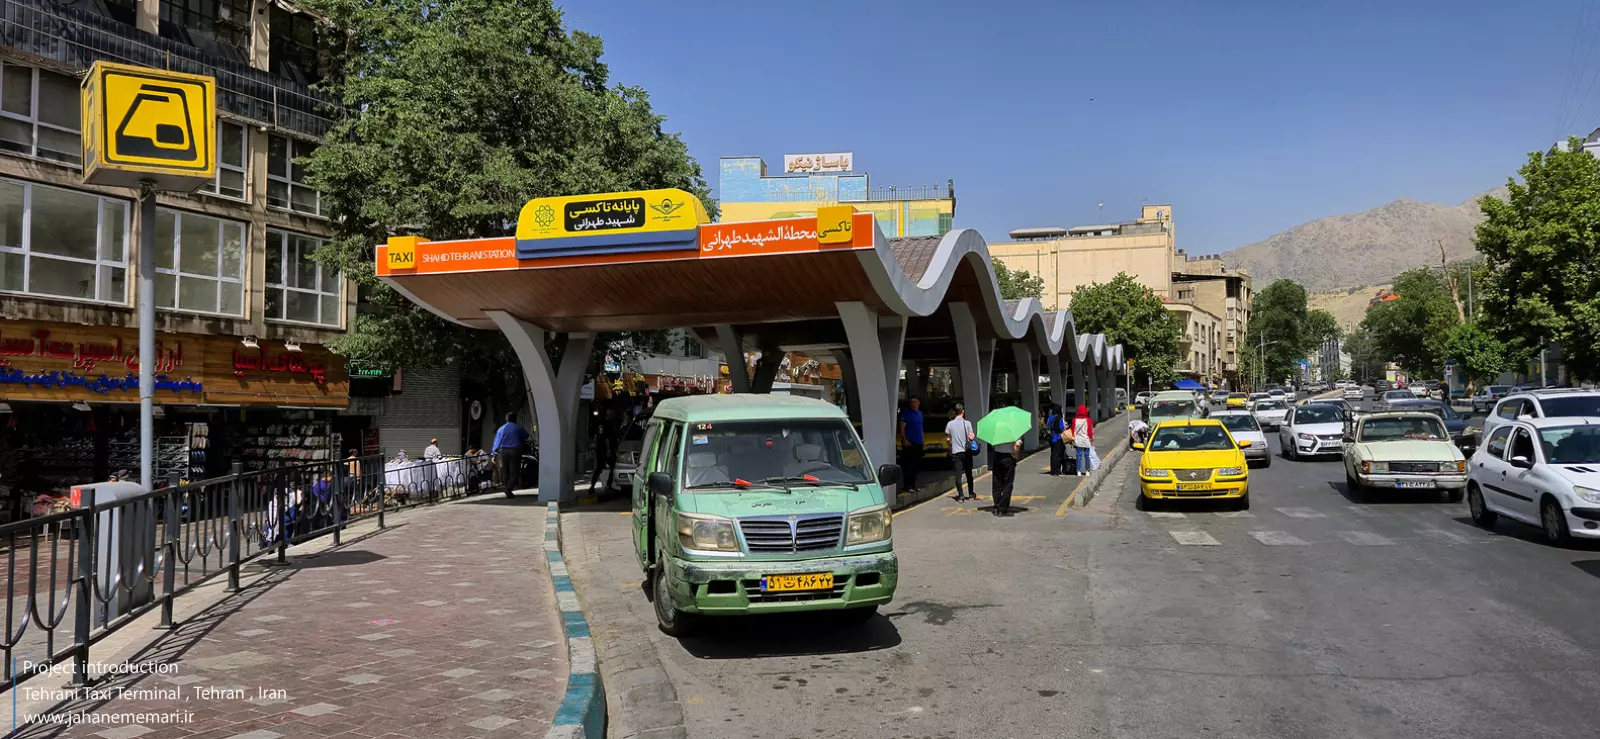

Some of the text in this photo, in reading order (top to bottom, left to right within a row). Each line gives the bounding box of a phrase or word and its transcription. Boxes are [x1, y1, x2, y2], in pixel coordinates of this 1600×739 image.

[787, 155, 849, 173] پاساژ نیکو
[569, 200, 640, 219] پایانه تاکسی
[574, 217, 605, 231] طهرانی
[605, 214, 636, 228] شهید
[818, 221, 852, 238] تاکسی
[702, 230, 741, 251] طهرانی
[389, 252, 414, 263] TAXI
[422, 249, 515, 263] SHAHID TEHRANI STATION
[125, 340, 183, 373] ارزن
[232, 345, 326, 385] پوشاک آسیا
[797, 576, 816, 588] ۴۸۶
